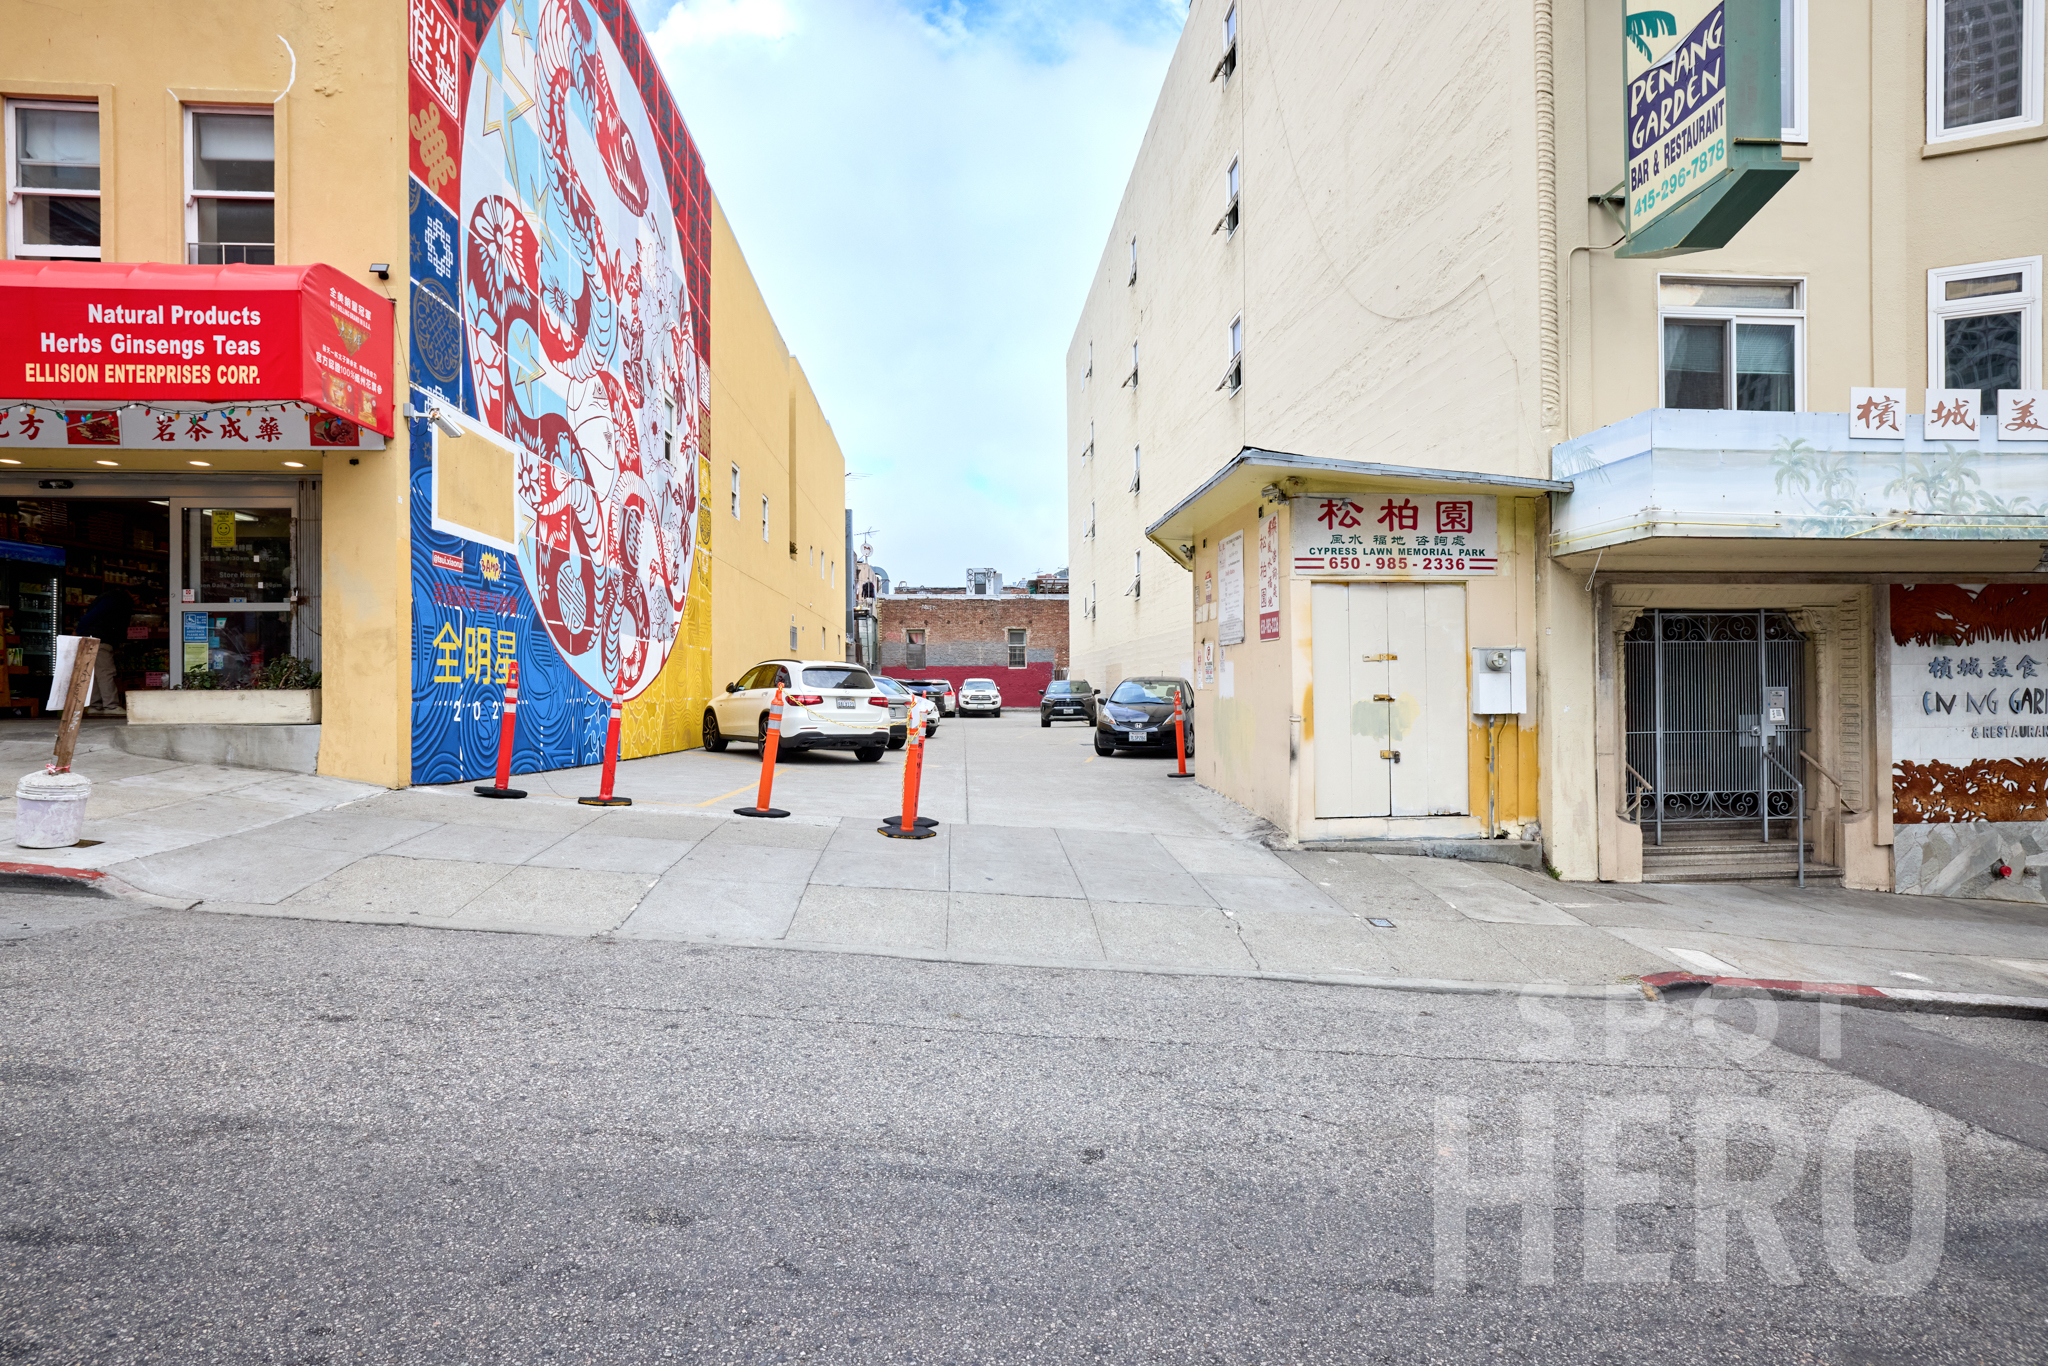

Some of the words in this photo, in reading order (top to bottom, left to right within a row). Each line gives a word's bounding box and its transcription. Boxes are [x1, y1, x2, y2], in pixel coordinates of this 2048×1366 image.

[1630, 10, 1723, 118] PENANG
[1631, 57, 1721, 149] GARDEN
[1630, 157, 1649, 192] BAR
[1653, 150, 1660, 176] &
[1664, 97, 1725, 169] RESTAURANT
[1633, 138, 1725, 217] 415-296-7878
[88, 303, 164, 325] Natural
[171, 305, 261, 326] Products
[40, 332, 102, 353] Herbs
[110, 333, 205, 360] Ginsengs
[213, 335, 261, 356] Teas
[25, 363, 99, 383] ELLISION
[104, 364, 211, 384] ENTERPRISES
[217, 365, 261, 385] CORP.
[152, 415, 283, 443] 茗茶成藥
[1317, 498, 1473, 534] 松柏園
[1309, 547, 1358, 556] CYPRESS
[1363, 547, 1393, 556] LAWN
[1398, 547, 1453, 557] MEMORIAL
[1458, 548, 1486, 557] PARK
[1330, 533, 1364, 546] 風水
[1373, 534, 1406, 546] 福地
[480, 559, 502, 579] BAMP!
[1329, 557, 1361, 570] 650
[1376, 557, 1408, 570] 985
[1422, 557, 1466, 571] 2336
[432, 621, 517, 685] 全明星
[1928, 654, 2042, 680] 檳城美食
[453, 700, 499, 722] 202
[2008, 687, 2048, 715] GAR
[1971, 726, 1980, 739] &
